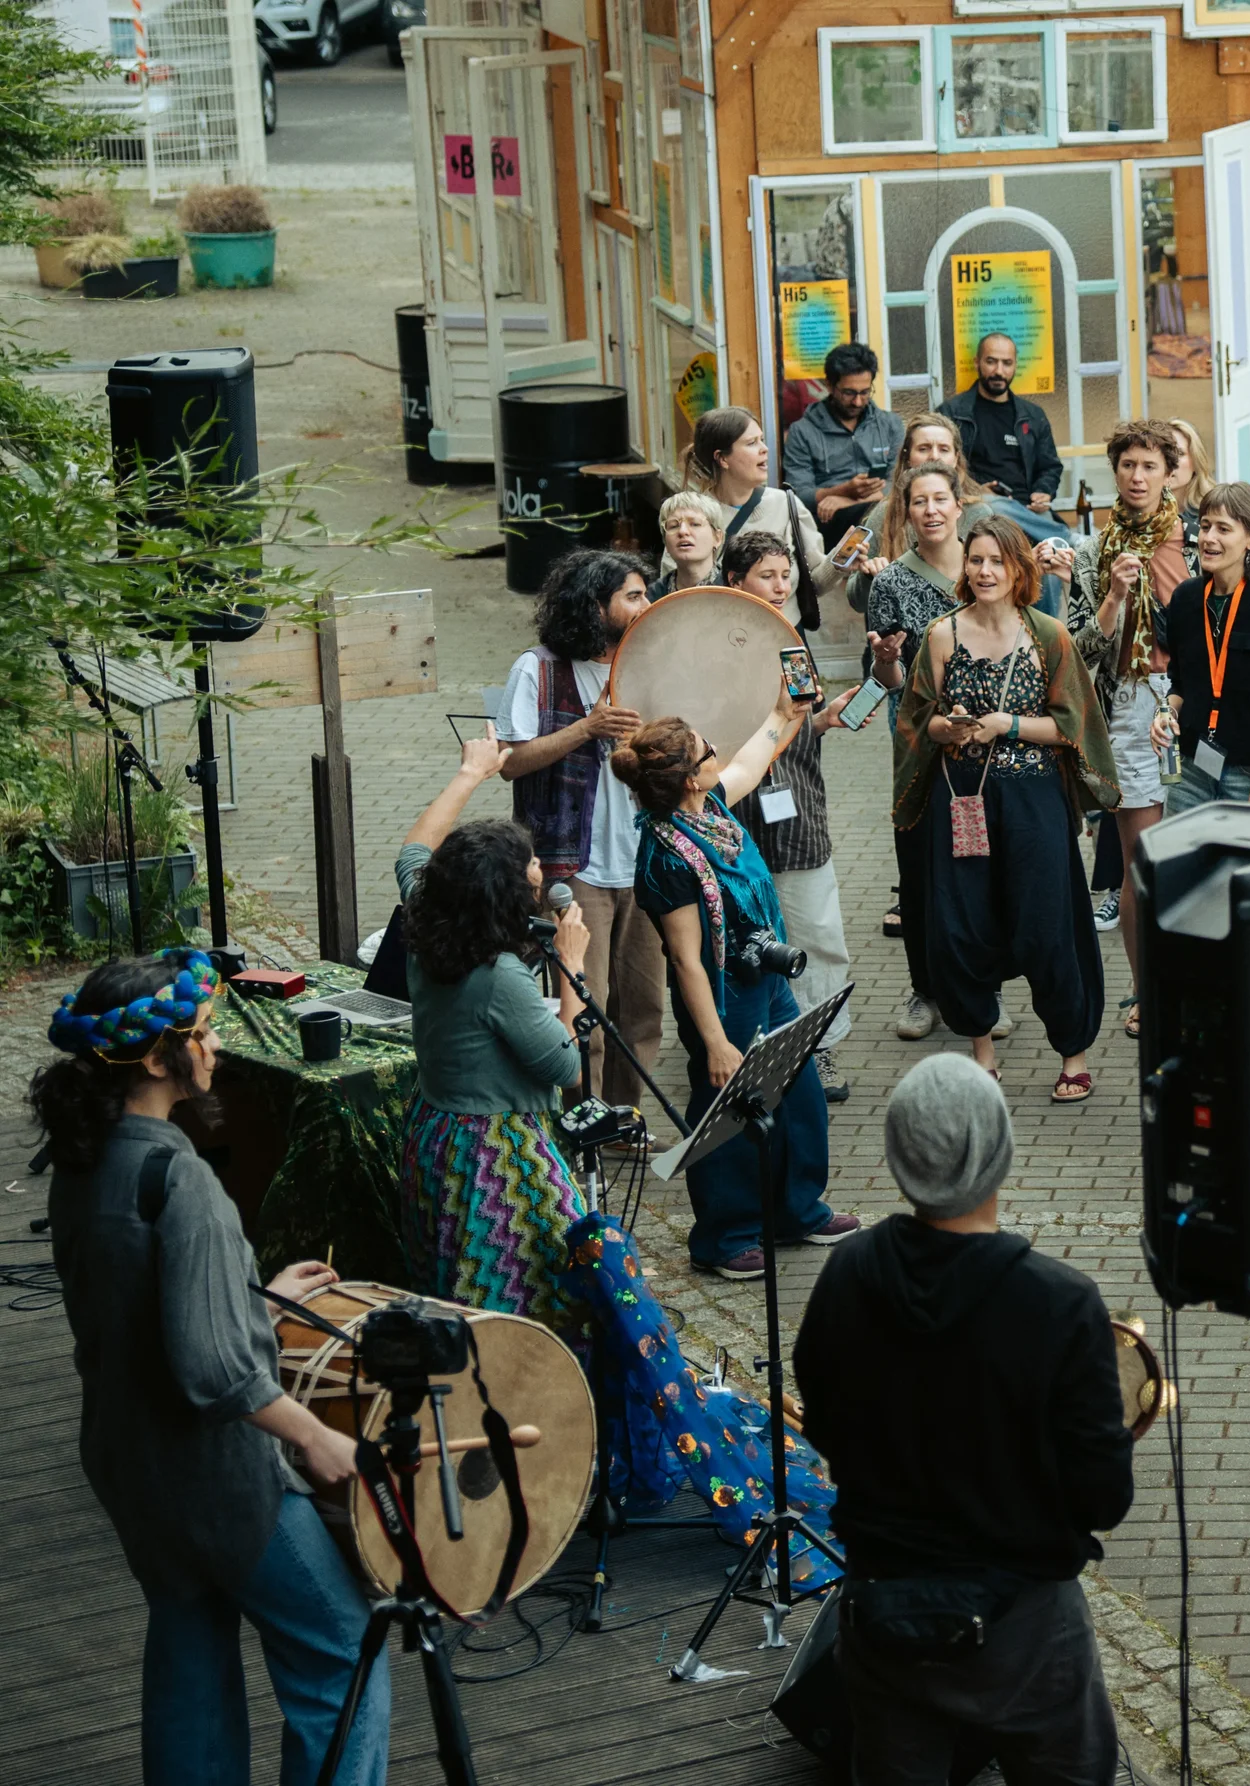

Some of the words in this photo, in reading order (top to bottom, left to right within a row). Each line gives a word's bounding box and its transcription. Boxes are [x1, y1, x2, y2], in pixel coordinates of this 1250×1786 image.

[460, 144, 506, 181] BR
[957, 260, 992, 283] Hi5
[783, 286, 808, 303] Hi5
[956, 296, 996, 308] Exhibition
[998, 294, 1033, 305] schedule
[374, 1481, 403, 1535] Canon
